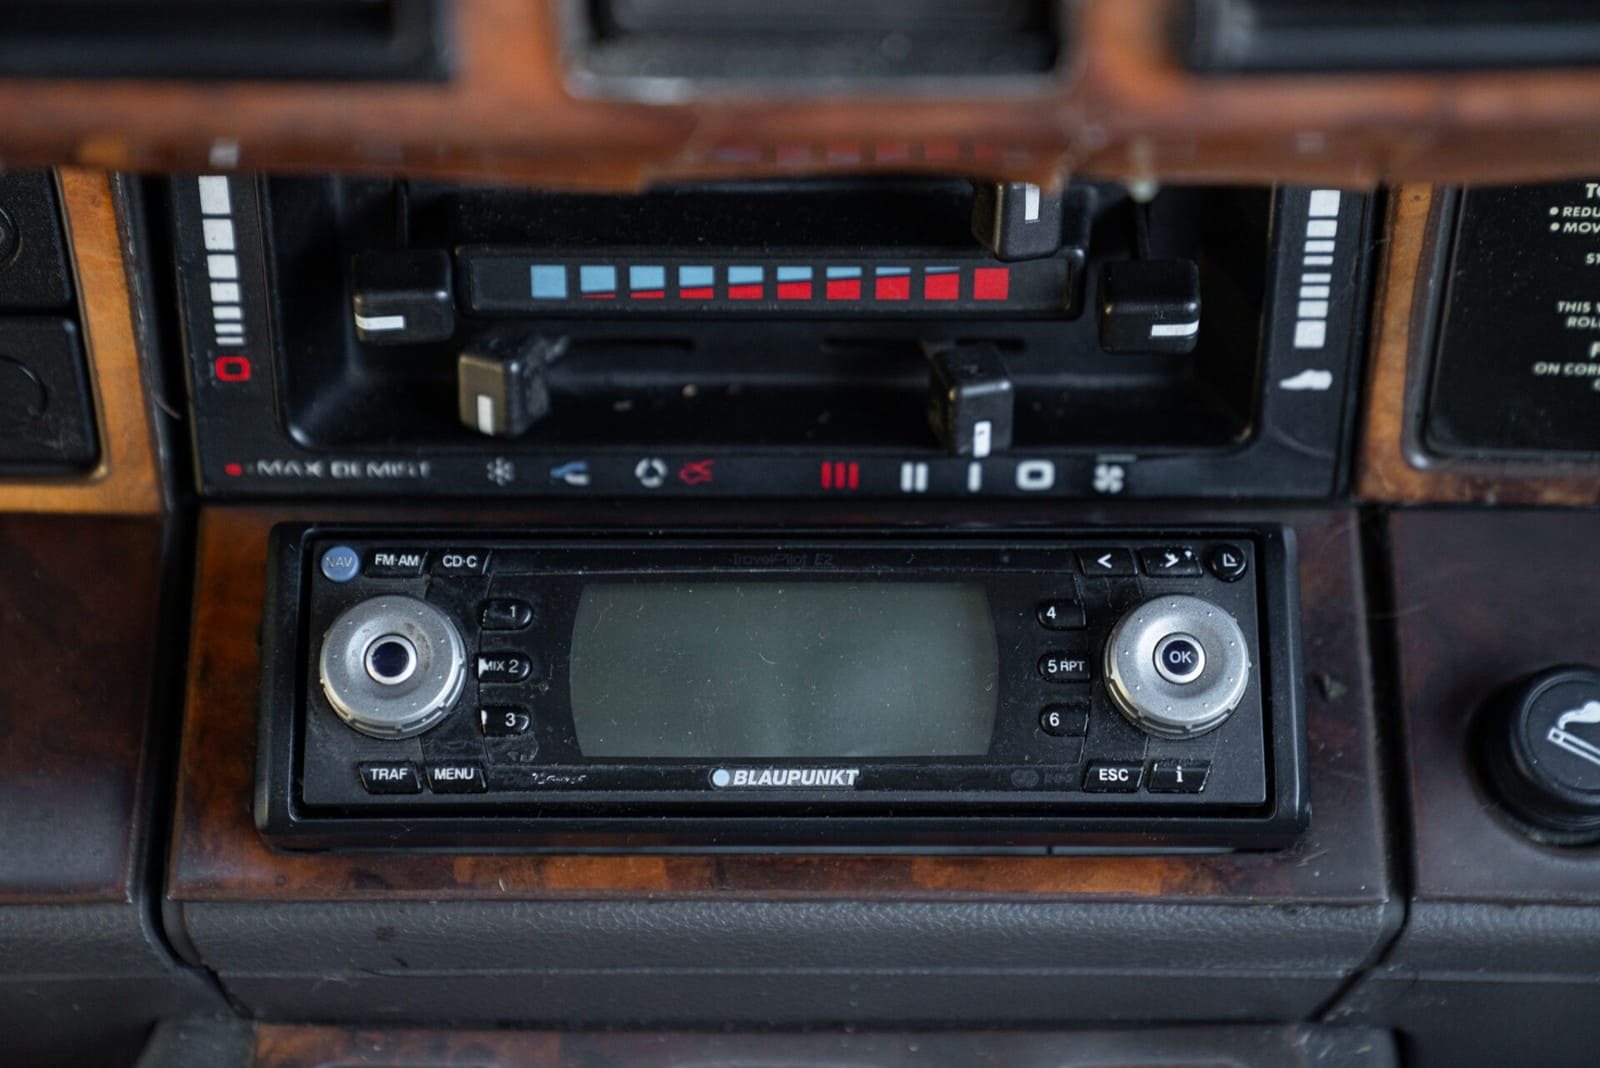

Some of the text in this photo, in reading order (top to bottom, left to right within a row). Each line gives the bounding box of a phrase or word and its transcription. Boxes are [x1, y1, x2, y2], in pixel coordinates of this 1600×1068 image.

[1558, 301, 1591, 313] THIS
[1567, 316, 1600, 328] ROL
[1534, 362, 1561, 375] ON
[326, 556, 353, 568] NAV
[509, 605, 516, 618] 1
[1046, 606, 1057, 619] 4
[1169, 650, 1193, 664] OK
[486, 659, 519, 674] MIX 2
[1047, 659, 1085, 673] 5 RPT
[504, 712, 516, 727] 3
[1049, 713, 1060, 727] 6
[370, 768, 409, 780] TRAF
[434, 767, 475, 780] MENU
[733, 769, 860, 786] BLAUPUNKT
[1099, 768, 1129, 781] ESC
